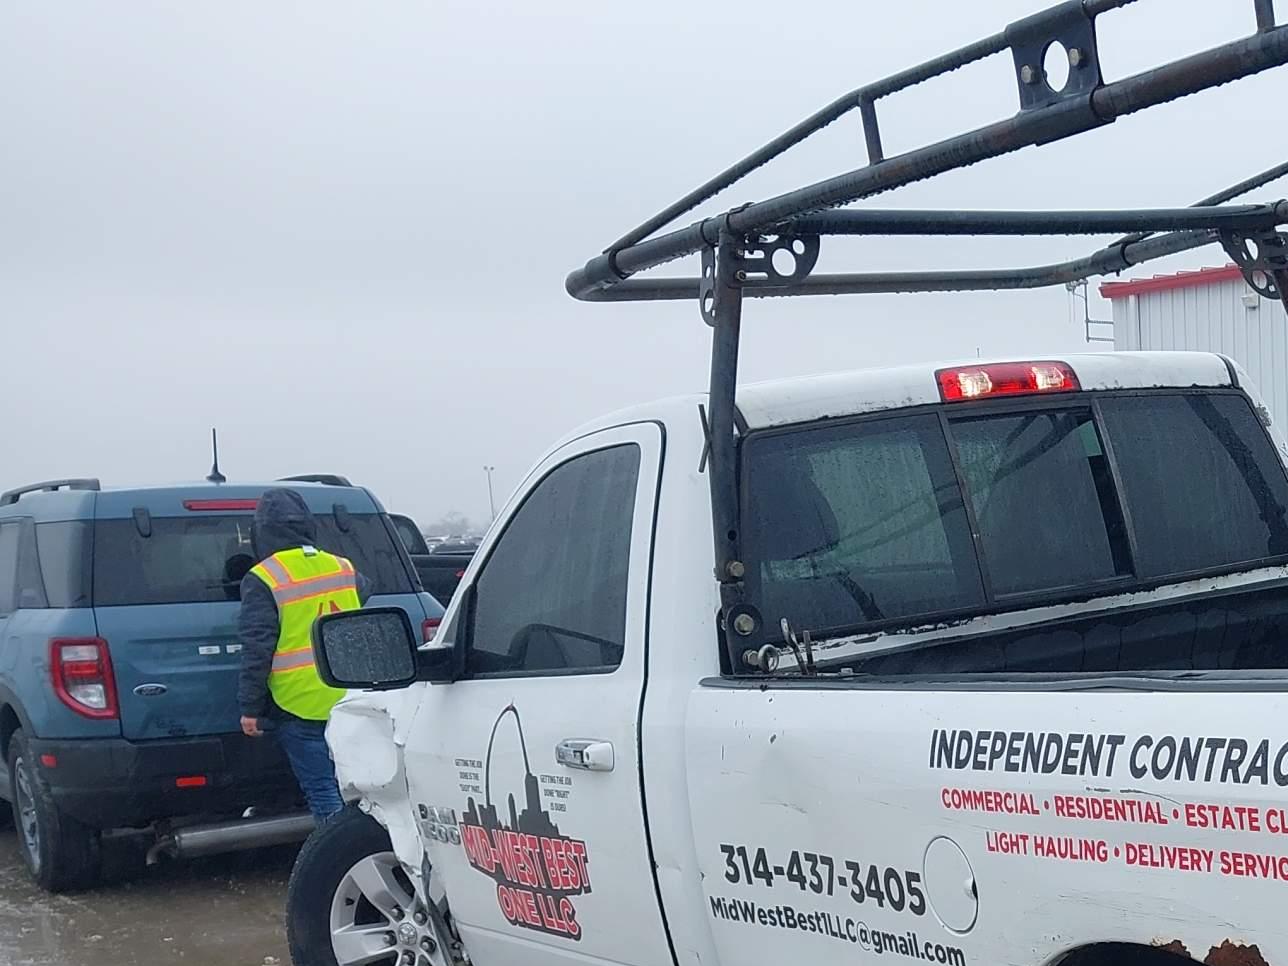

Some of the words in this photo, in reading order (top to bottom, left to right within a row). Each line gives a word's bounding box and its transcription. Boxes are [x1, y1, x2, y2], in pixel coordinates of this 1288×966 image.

[929, 729, 1125, 777] INDEPENDENT
[941, 788, 1040, 815] COMMERCIAL
[1054, 795, 1168, 825] RESIDENTIAL
[1185, 804, 1261, 832] ESTATE
[460, 823, 546, 888] MID-WEST
[540, 837, 589, 890] BEST
[986, 831, 1029, 854] LIGHT
[1033, 836, 1108, 863] HAULING
[1125, 843, 1213, 873] DELIVERY
[720, 844, 926, 916] 314-437-3405
[498, 885, 542, 926] ONE
[536, 893, 579, 935] LLC
